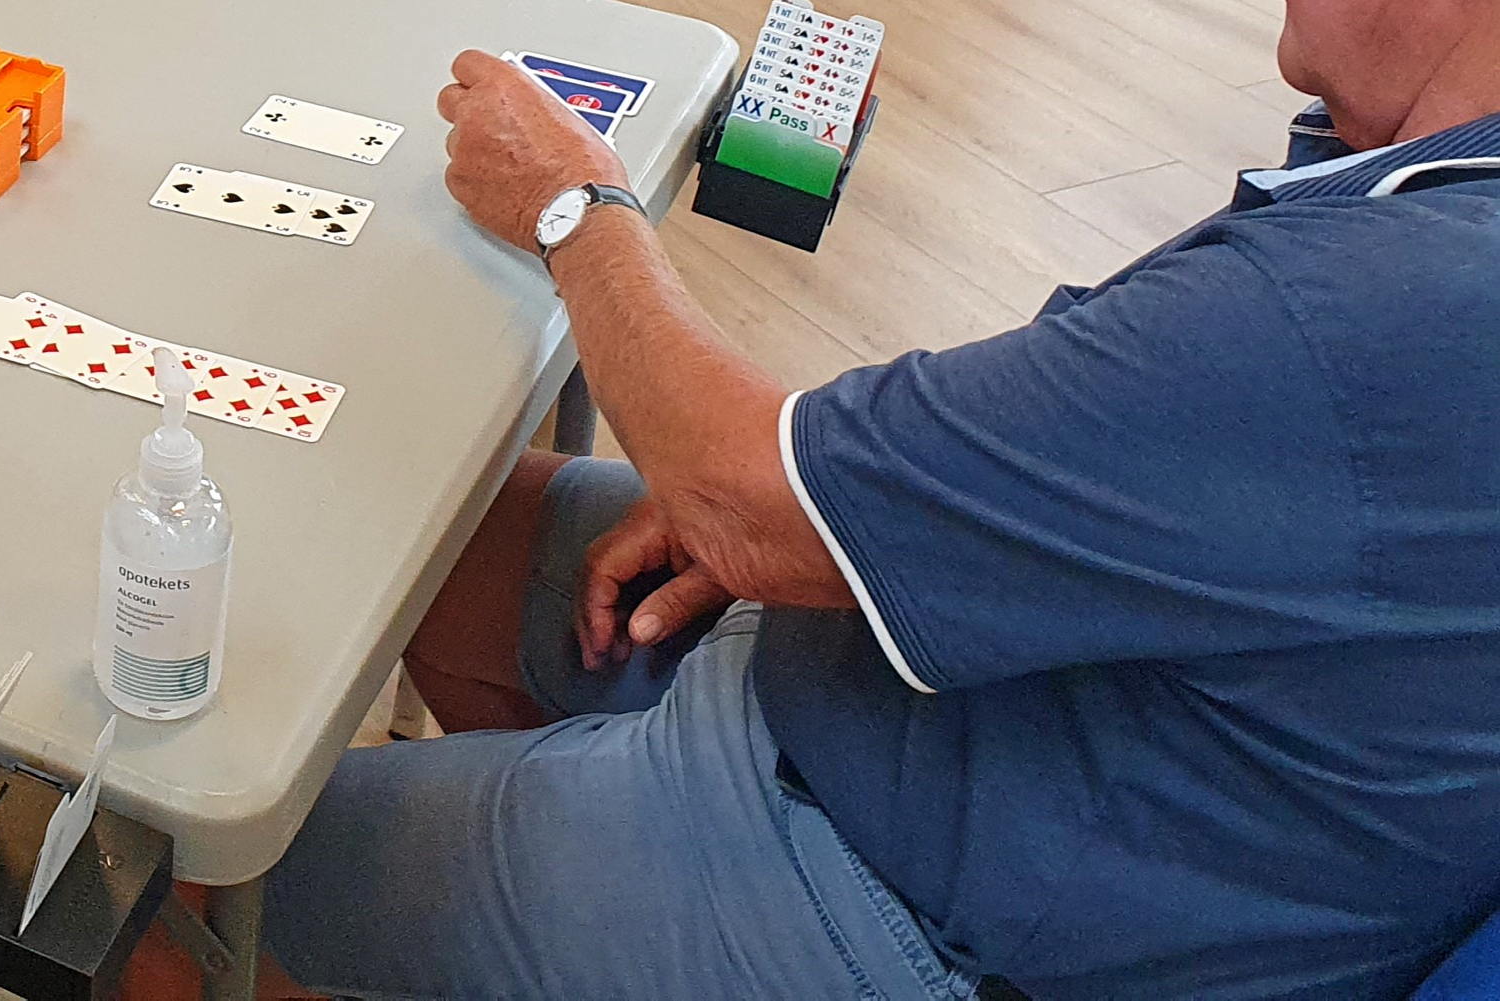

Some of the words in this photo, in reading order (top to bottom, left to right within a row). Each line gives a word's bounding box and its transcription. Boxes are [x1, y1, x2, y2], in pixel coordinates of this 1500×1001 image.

[737, 95, 765, 116] XX
[769, 107, 808, 131] Pass
[822, 122, 838, 140] X
[194, 354, 208, 362] 8
[119, 566, 190, 590] apotekets
[118, 587, 157, 606] ALCOGEL
